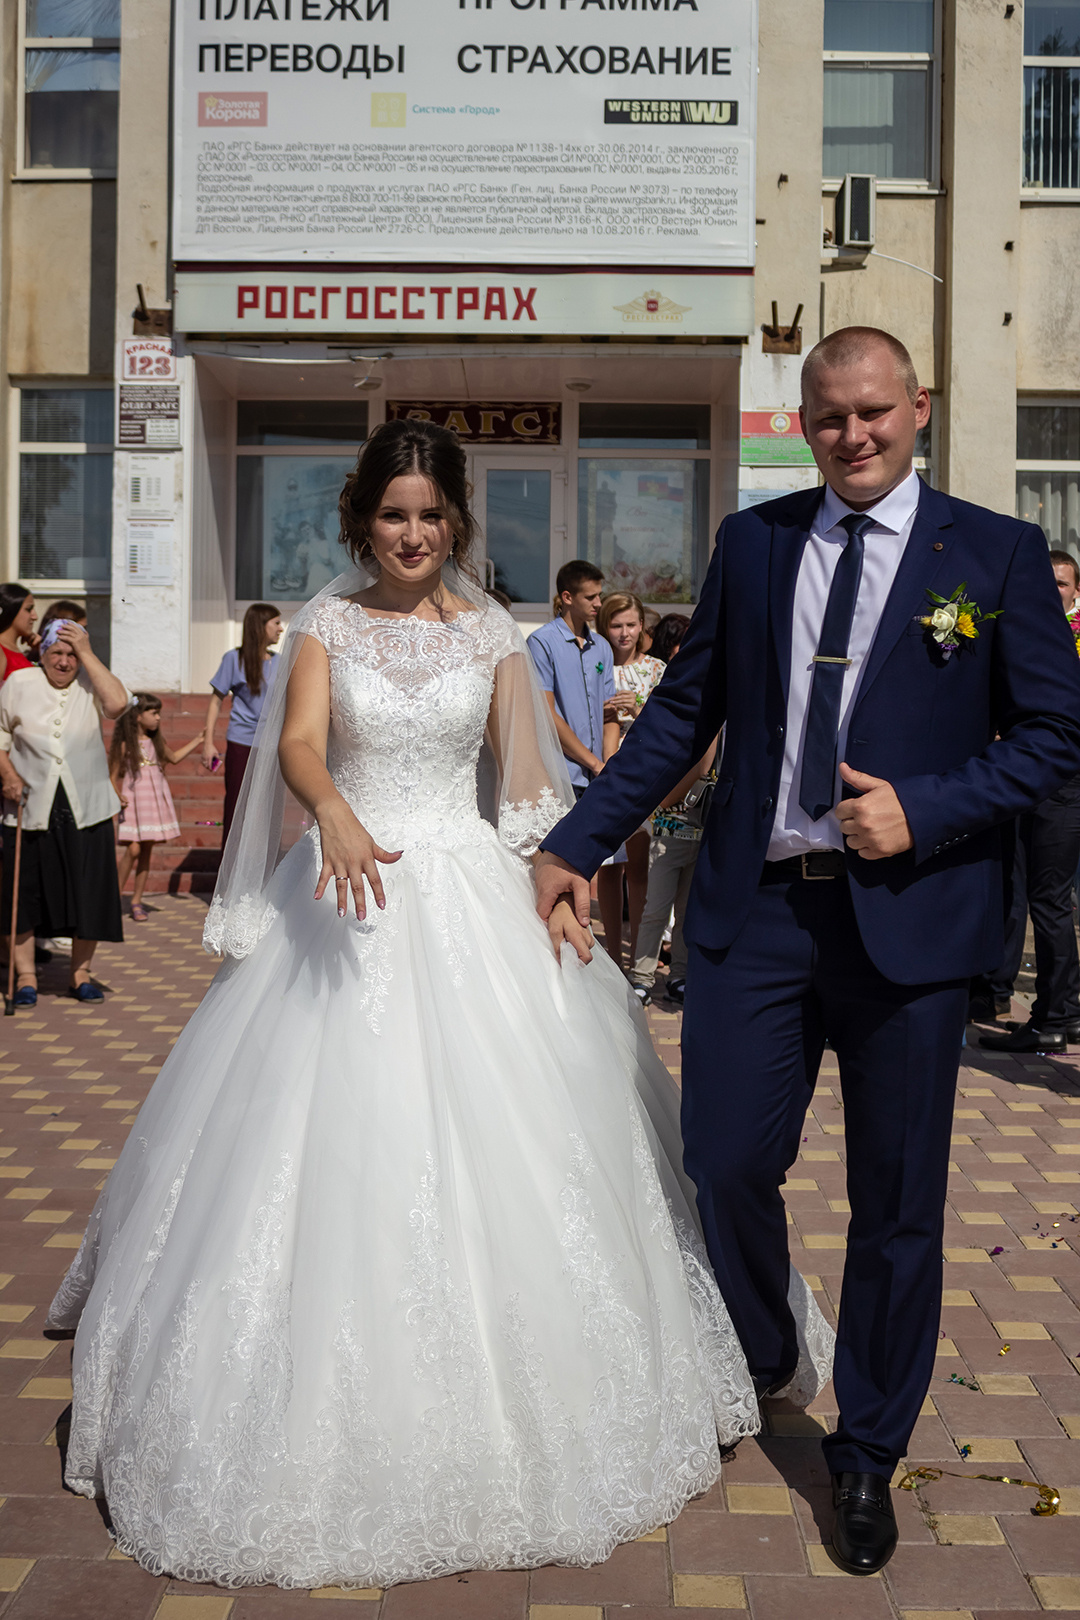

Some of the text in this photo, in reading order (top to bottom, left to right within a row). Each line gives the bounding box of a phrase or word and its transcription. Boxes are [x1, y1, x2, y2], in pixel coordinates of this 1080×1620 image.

[199, 0, 389, 21] ПЛАТЕЖИ
[198, 43, 405, 79] ПЕРЕВОДЫ
[457, 44, 732, 75] СТРАХОВАНИЕ
[218, 98, 260, 108] Золотая
[412, 104, 500, 115] Система «Город»
[206, 107, 260, 122] Корона
[608, 101, 731, 123] WESTERN WU
[630, 111, 680, 122] UNION
[203, 142, 225, 151] ПАО
[228, 142, 252, 151] «РГС
[255, 142, 282, 151] Банк»
[285, 142, 336, 153] действует
[353, 144, 406, 152] основании
[467, 145, 514, 154] договора
[598, 144, 652, 153] 30.06.2014
[205, 152, 225, 161] ПАО
[227, 153, 239, 161] СК
[310, 155, 351, 163] лицензии
[354, 153, 380, 162] Банка
[382, 154, 414, 162] России
[430, 156, 499, 164] осуществление
[502, 156, 558, 164] страхования
[666, 155, 680, 164] ОС
[197, 163, 211, 172] ОС
[272, 163, 286, 172] ОС
[347, 164, 361, 172] ОС
[407, 164, 418, 173] 05
[441, 166, 511, 174] осуществление
[514, 167, 591, 175] перестрахования
[594, 165, 606, 174] ПС
[647, 167, 680, 176] выданы
[683, 166, 729, 174] 23.05.2016
[197, 183, 250, 194] Подробная
[254, 183, 314, 194] информация
[318, 185, 323, 193] о
[327, 185, 375, 194] продуктах
[379, 185, 385, 193] и
[388, 186, 425, 194] услугах
[428, 184, 449, 193] ПАО
[453, 184, 476, 193] «РГС
[481, 184, 508, 193] Банк»
[512, 184, 532, 195] (Ген.
[537, 186, 556, 195] лиц.
[560, 185, 587, 194] Банка
[591, 185, 626, 194] России
[695, 185, 738, 196] телефону
[274, 194, 340, 204] Контакт-центра
[342, 194, 348, 202] 8
[350, 195, 370, 204] (800)
[372, 195, 414, 203] 700-11-99
[417, 195, 449, 204] (звонок
[464, 195, 495, 203] России
[498, 195, 551, 205] бесплатный)
[584, 196, 608, 204] сайте
[680, 196, 737, 206] Информация
[204, 206, 238, 214] данном
[242, 206, 289, 214] материале
[321, 205, 376, 214] справочный
[379, 206, 420, 215] характер
[490, 205, 538, 215] публичной
[585, 206, 619, 216] Вклады
[690, 206, 710, 215] ЗАО
[197, 213, 240, 222] линговый
[280, 214, 306, 222] РНКО
[309, 214, 366, 222] «Платежный
[369, 214, 402, 224] Центр»
[437, 215, 482, 225] Лицензия
[486, 215, 514, 223] Банка
[517, 215, 552, 224] России
[607, 216, 630, 224] ООО
[633, 216, 658, 224] «НКО
[662, 216, 701, 226] Вестерн
[705, 216, 737, 225] Юнион
[196, 224, 210, 234] ДП
[257, 224, 304, 234] Лицензия
[307, 225, 335, 233] Банка
[338, 225, 373, 233] России
[430, 225, 497, 235] Предложение
[499, 226, 574, 236] действительно
[591, 226, 645, 235] 10.08.2016
[657, 227, 700, 235] Реклама.
[237, 285, 538, 320] РОСГОССТРАХ
[126, 343, 174, 356] КРАСНАЯ
[129, 355, 171, 375] 123
[121, 401, 178, 409] ОТДЕЛ ЗАГС
